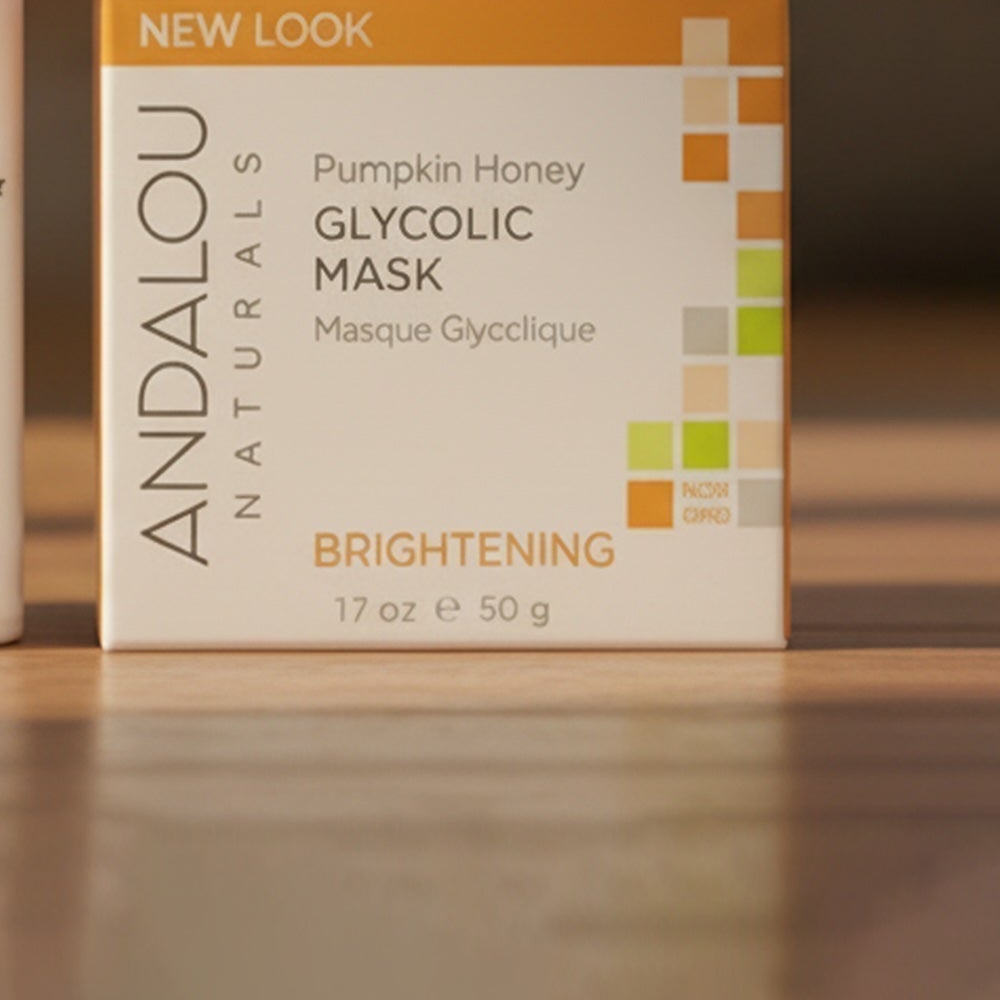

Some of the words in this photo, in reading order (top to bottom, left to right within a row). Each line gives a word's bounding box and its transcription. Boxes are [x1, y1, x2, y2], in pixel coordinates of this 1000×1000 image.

[139, 13, 241, 48] NEW
[254, 12, 373, 48] LOOK
[313, 153, 462, 191] Pumpkin
[474, 153, 585, 191] Honey
[314, 205, 534, 242] GLYCOLIC
[314, 257, 443, 292] MASK
[137, 105, 209, 566] ANDALOU
[233, 152, 263, 519] NATURALS
[314, 316, 432, 349] Masque
[314, 532, 615, 568] BRIGHTENING
[336, 596, 369, 623] 17
[379, 600, 417, 623] oz
[479, 595, 519, 622] 50
[530, 601, 550, 628] g
